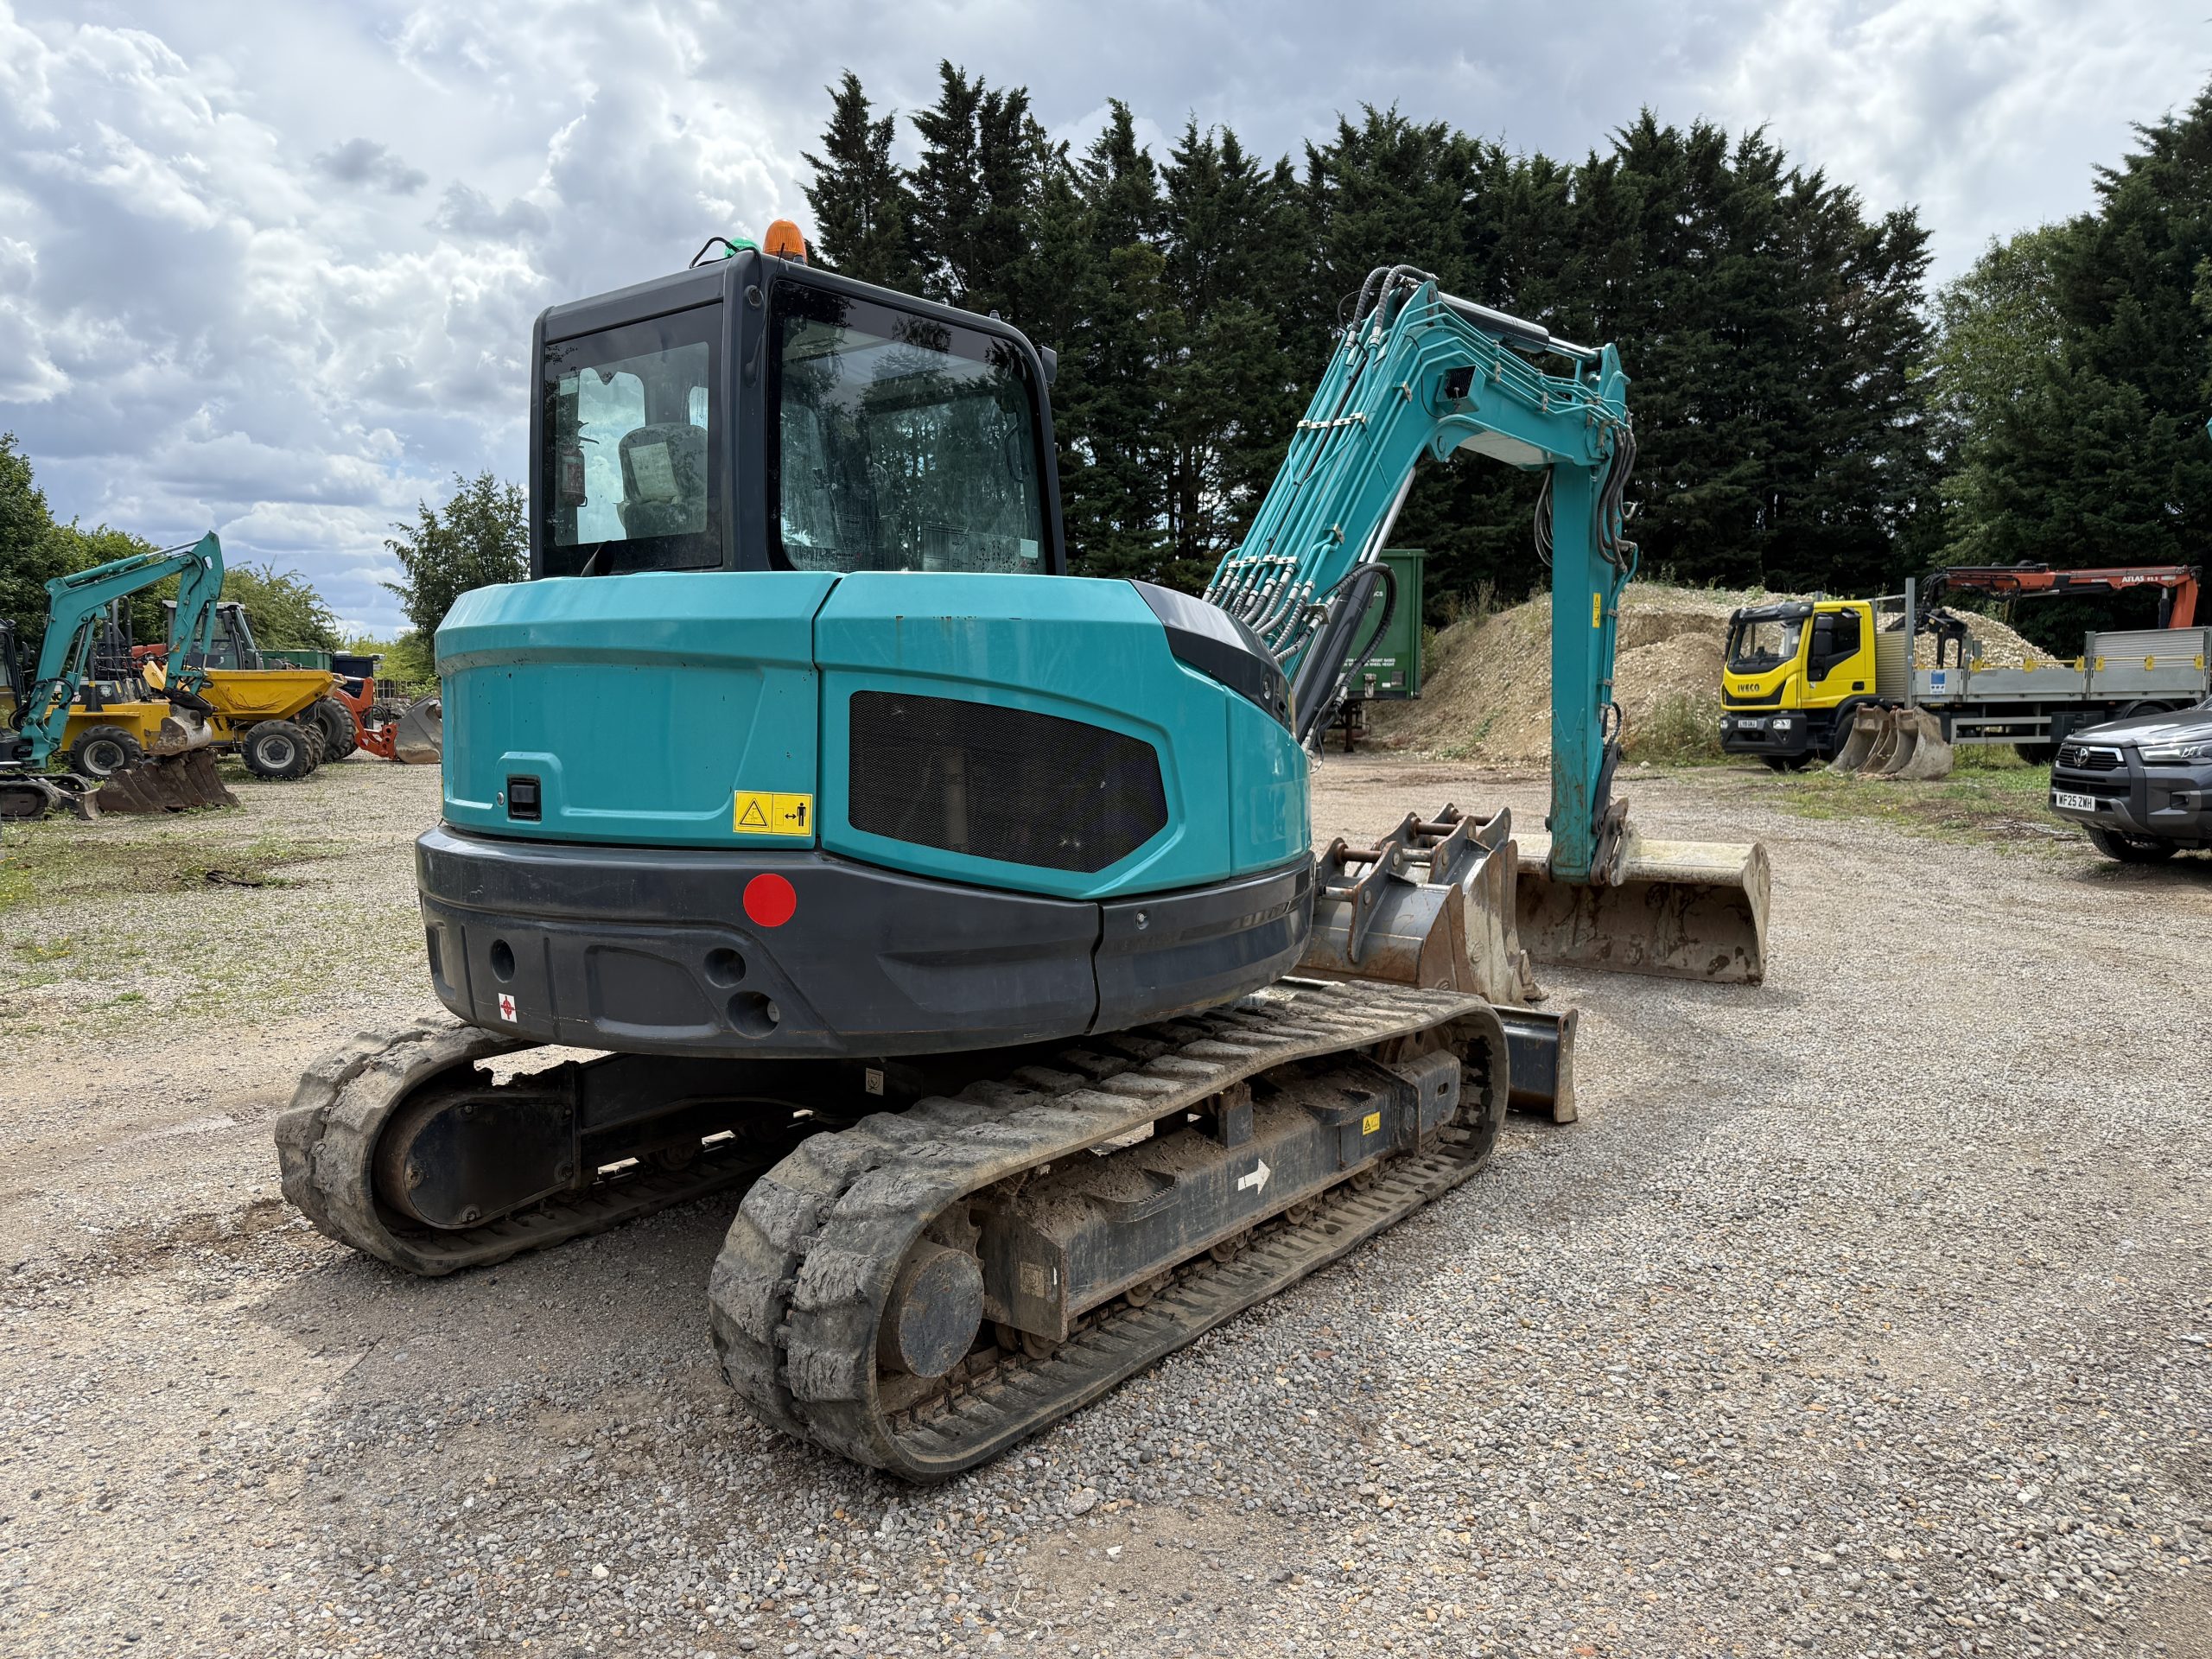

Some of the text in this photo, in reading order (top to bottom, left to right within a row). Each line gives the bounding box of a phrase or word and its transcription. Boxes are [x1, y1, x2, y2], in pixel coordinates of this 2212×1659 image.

[1738, 683, 1759, 692] IVECO
[2059, 793, 2092, 809] WF25 ZWH
